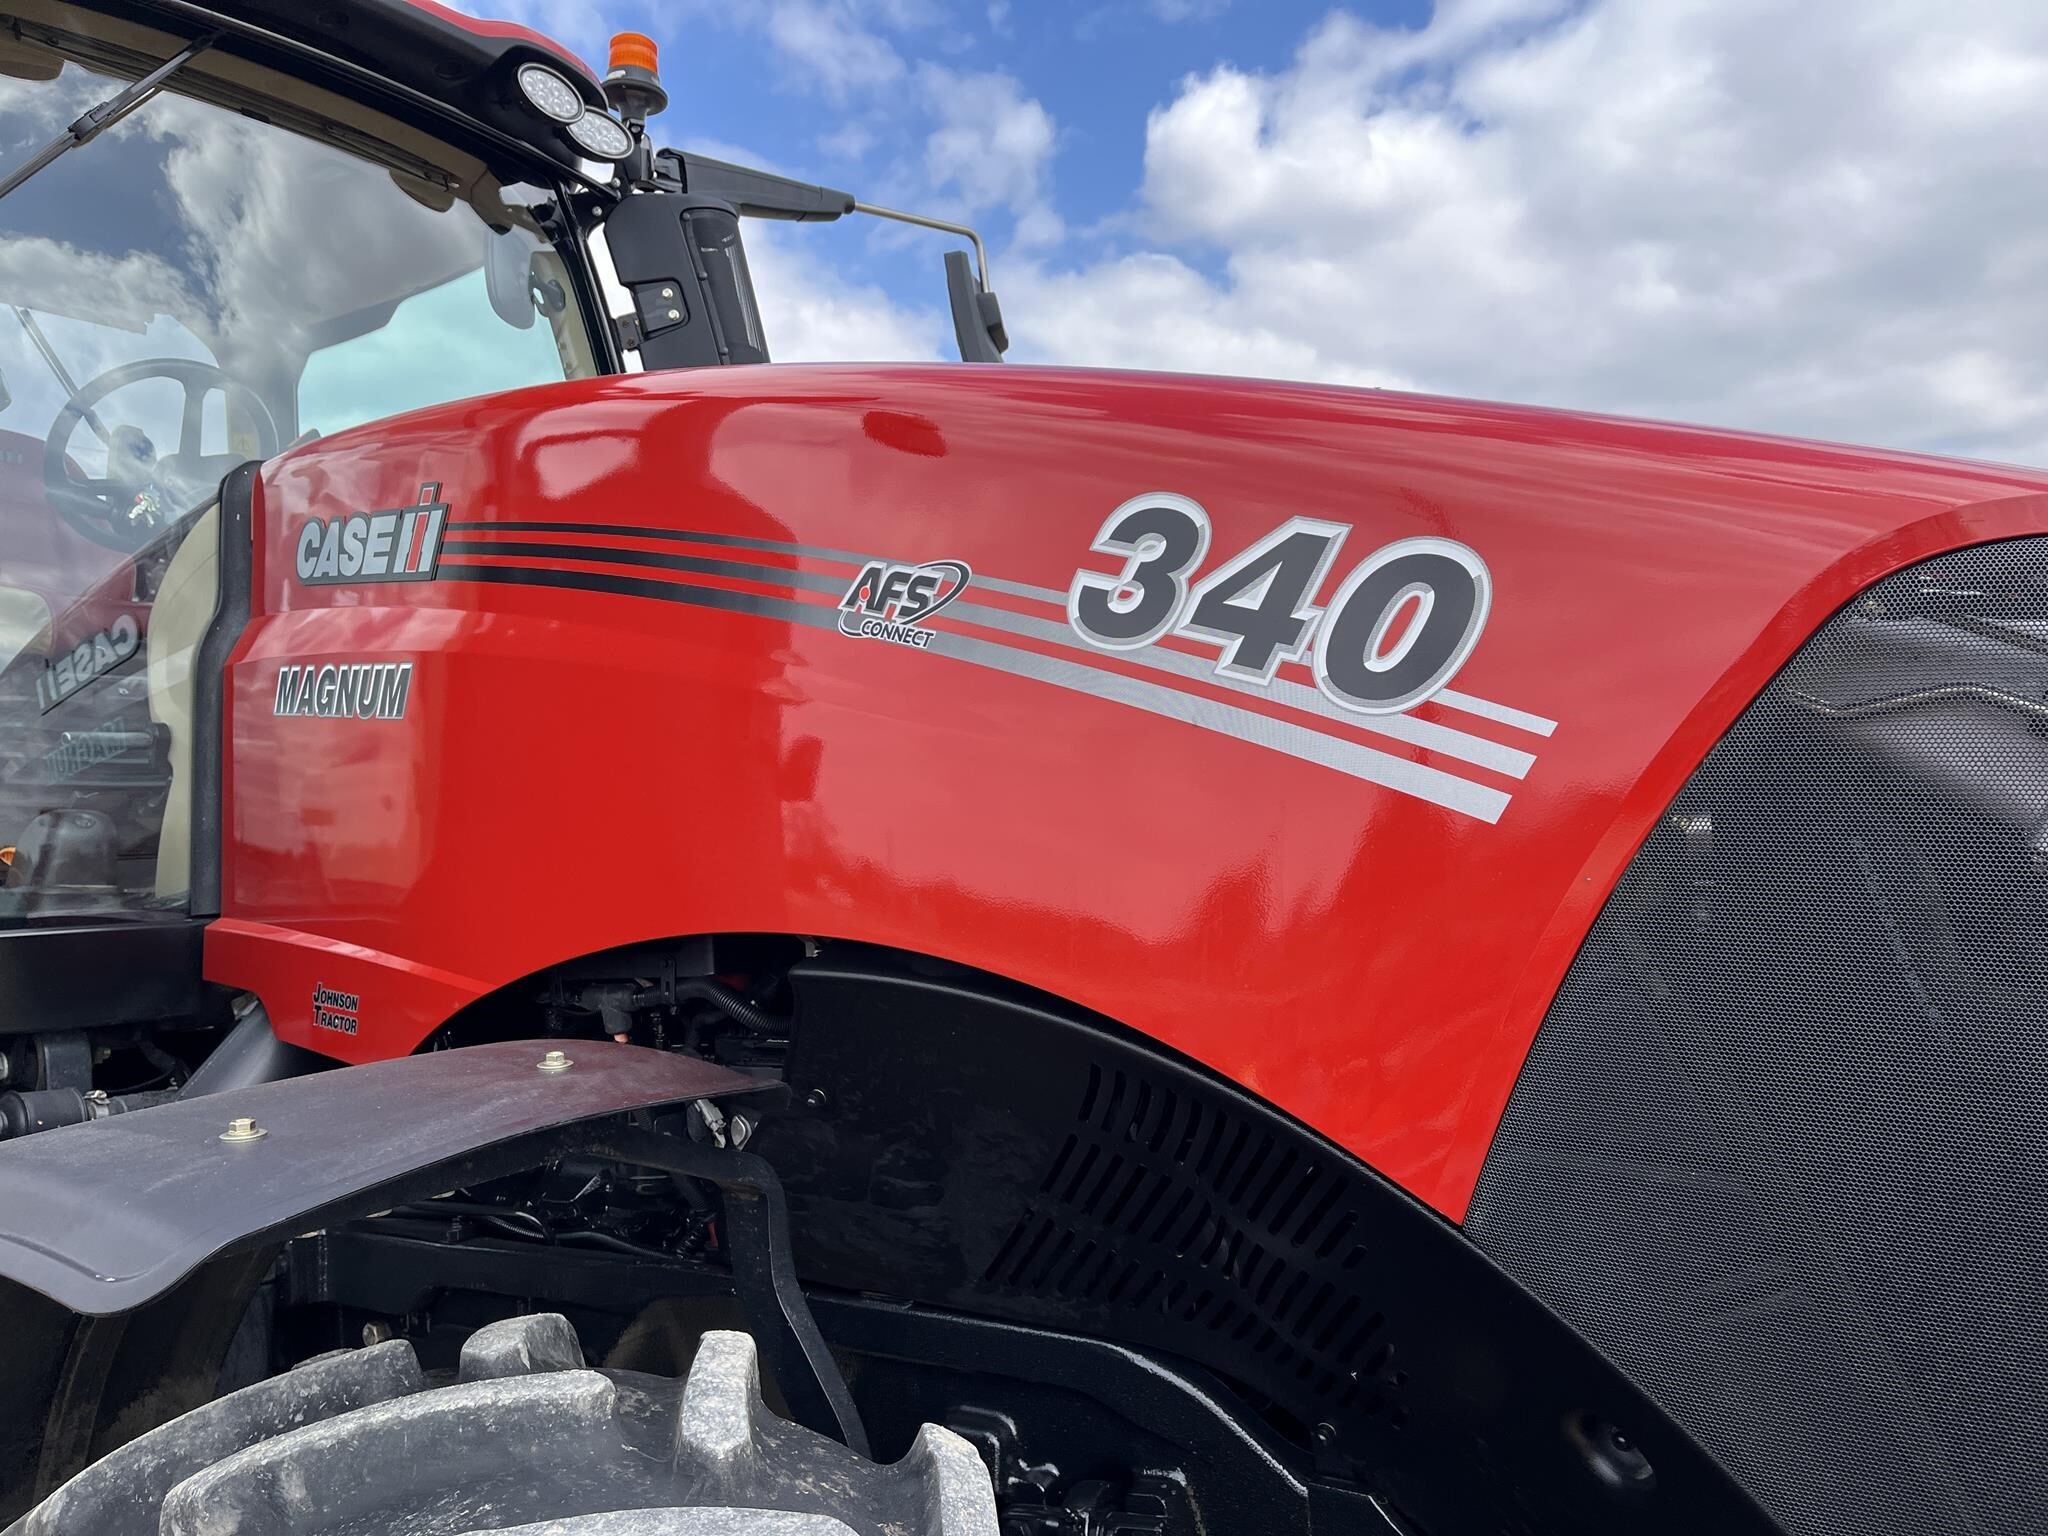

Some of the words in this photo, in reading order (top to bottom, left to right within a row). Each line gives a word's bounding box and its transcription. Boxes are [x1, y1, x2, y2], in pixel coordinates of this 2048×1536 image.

[838, 561, 945, 618] AFS
[1066, 491, 1493, 714] 340
[860, 618, 936, 649] CONNECT
[273, 663, 413, 719] MAGNUM
[313, 982, 359, 1012] JOHNSON
[313, 1004, 358, 1035] TRACTOR
